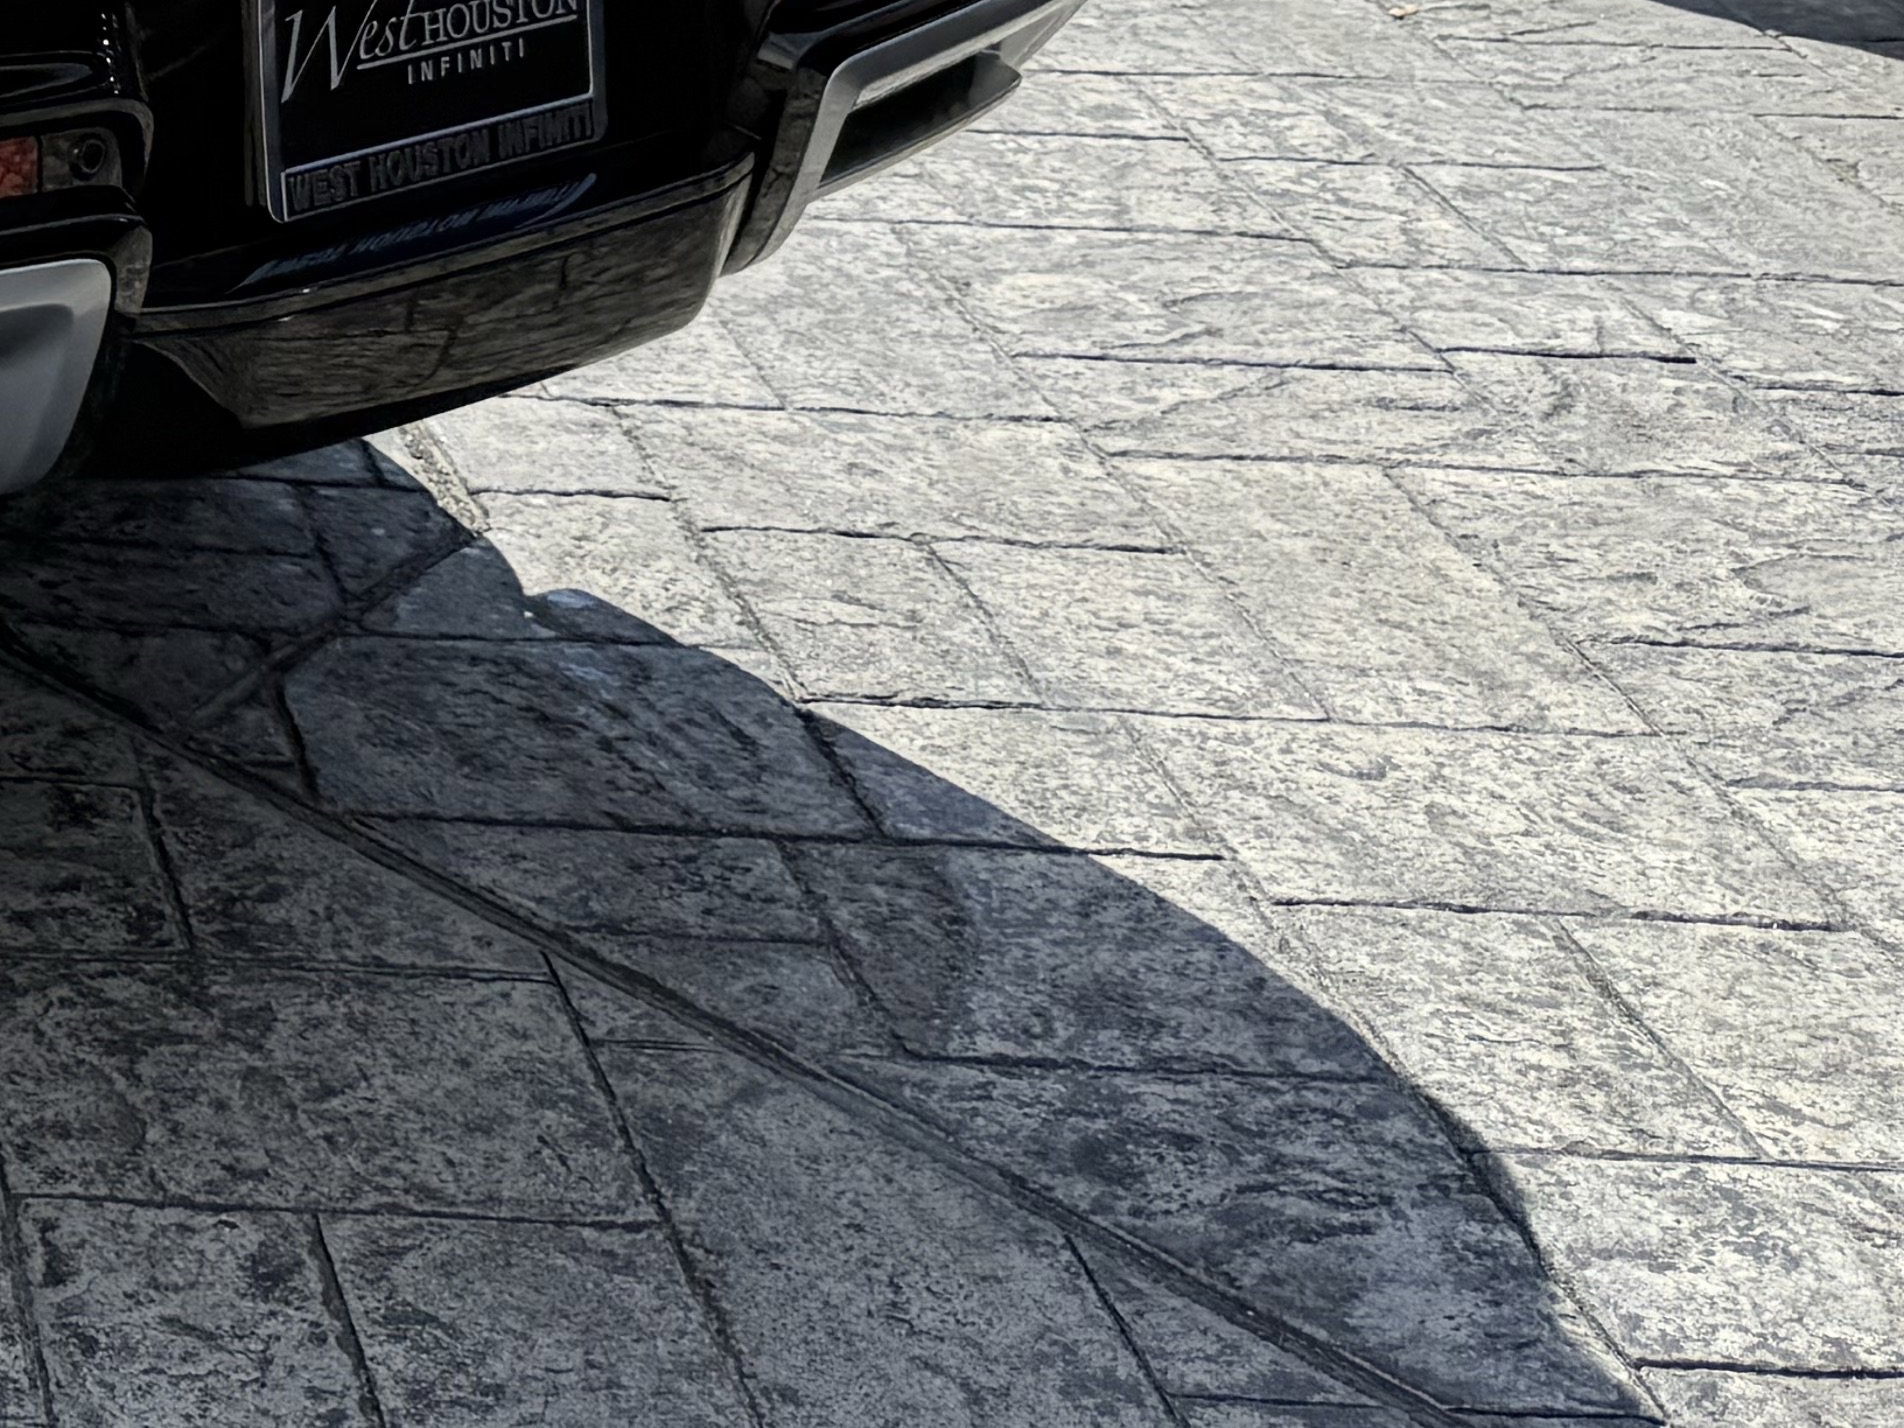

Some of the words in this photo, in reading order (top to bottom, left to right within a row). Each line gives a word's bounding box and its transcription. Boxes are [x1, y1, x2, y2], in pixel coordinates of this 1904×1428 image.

[406, 37, 525, 85] INFINITI
[288, 159, 362, 212] WEST
[368, 128, 492, 192] HOUSTON
[497, 101, 593, 159] INFINITI
